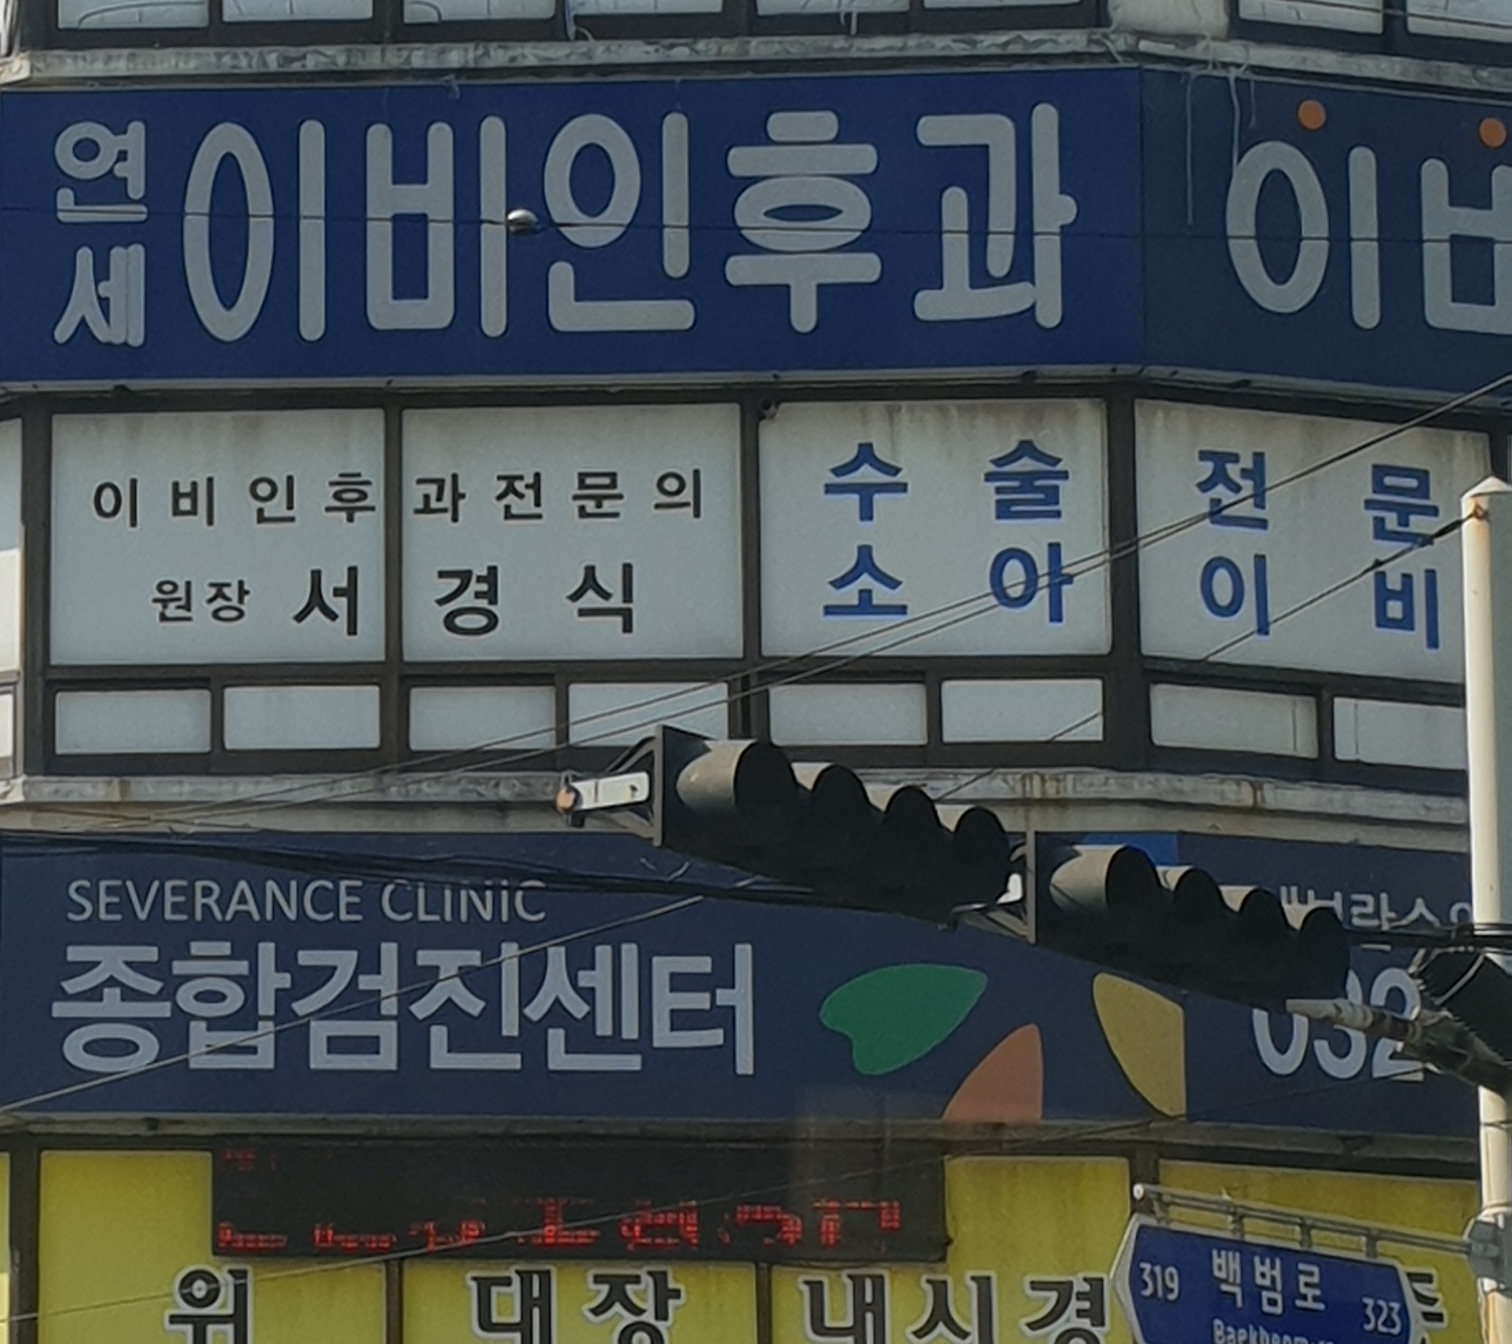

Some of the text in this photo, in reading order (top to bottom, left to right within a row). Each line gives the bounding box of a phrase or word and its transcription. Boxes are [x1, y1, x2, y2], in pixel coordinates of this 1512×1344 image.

[53, 102, 1078, 348] 연세 이비인후과
[150, 578, 251, 623] 원장
[65, 877, 548, 924] SEVERANCE CLINIC
[50, 938, 756, 1077] 종합검진센터
[1139, 1261, 1180, 1303] 319
[1211, 1248, 1326, 1317] 백범로
[1362, 1296, 1403, 1336] 323
